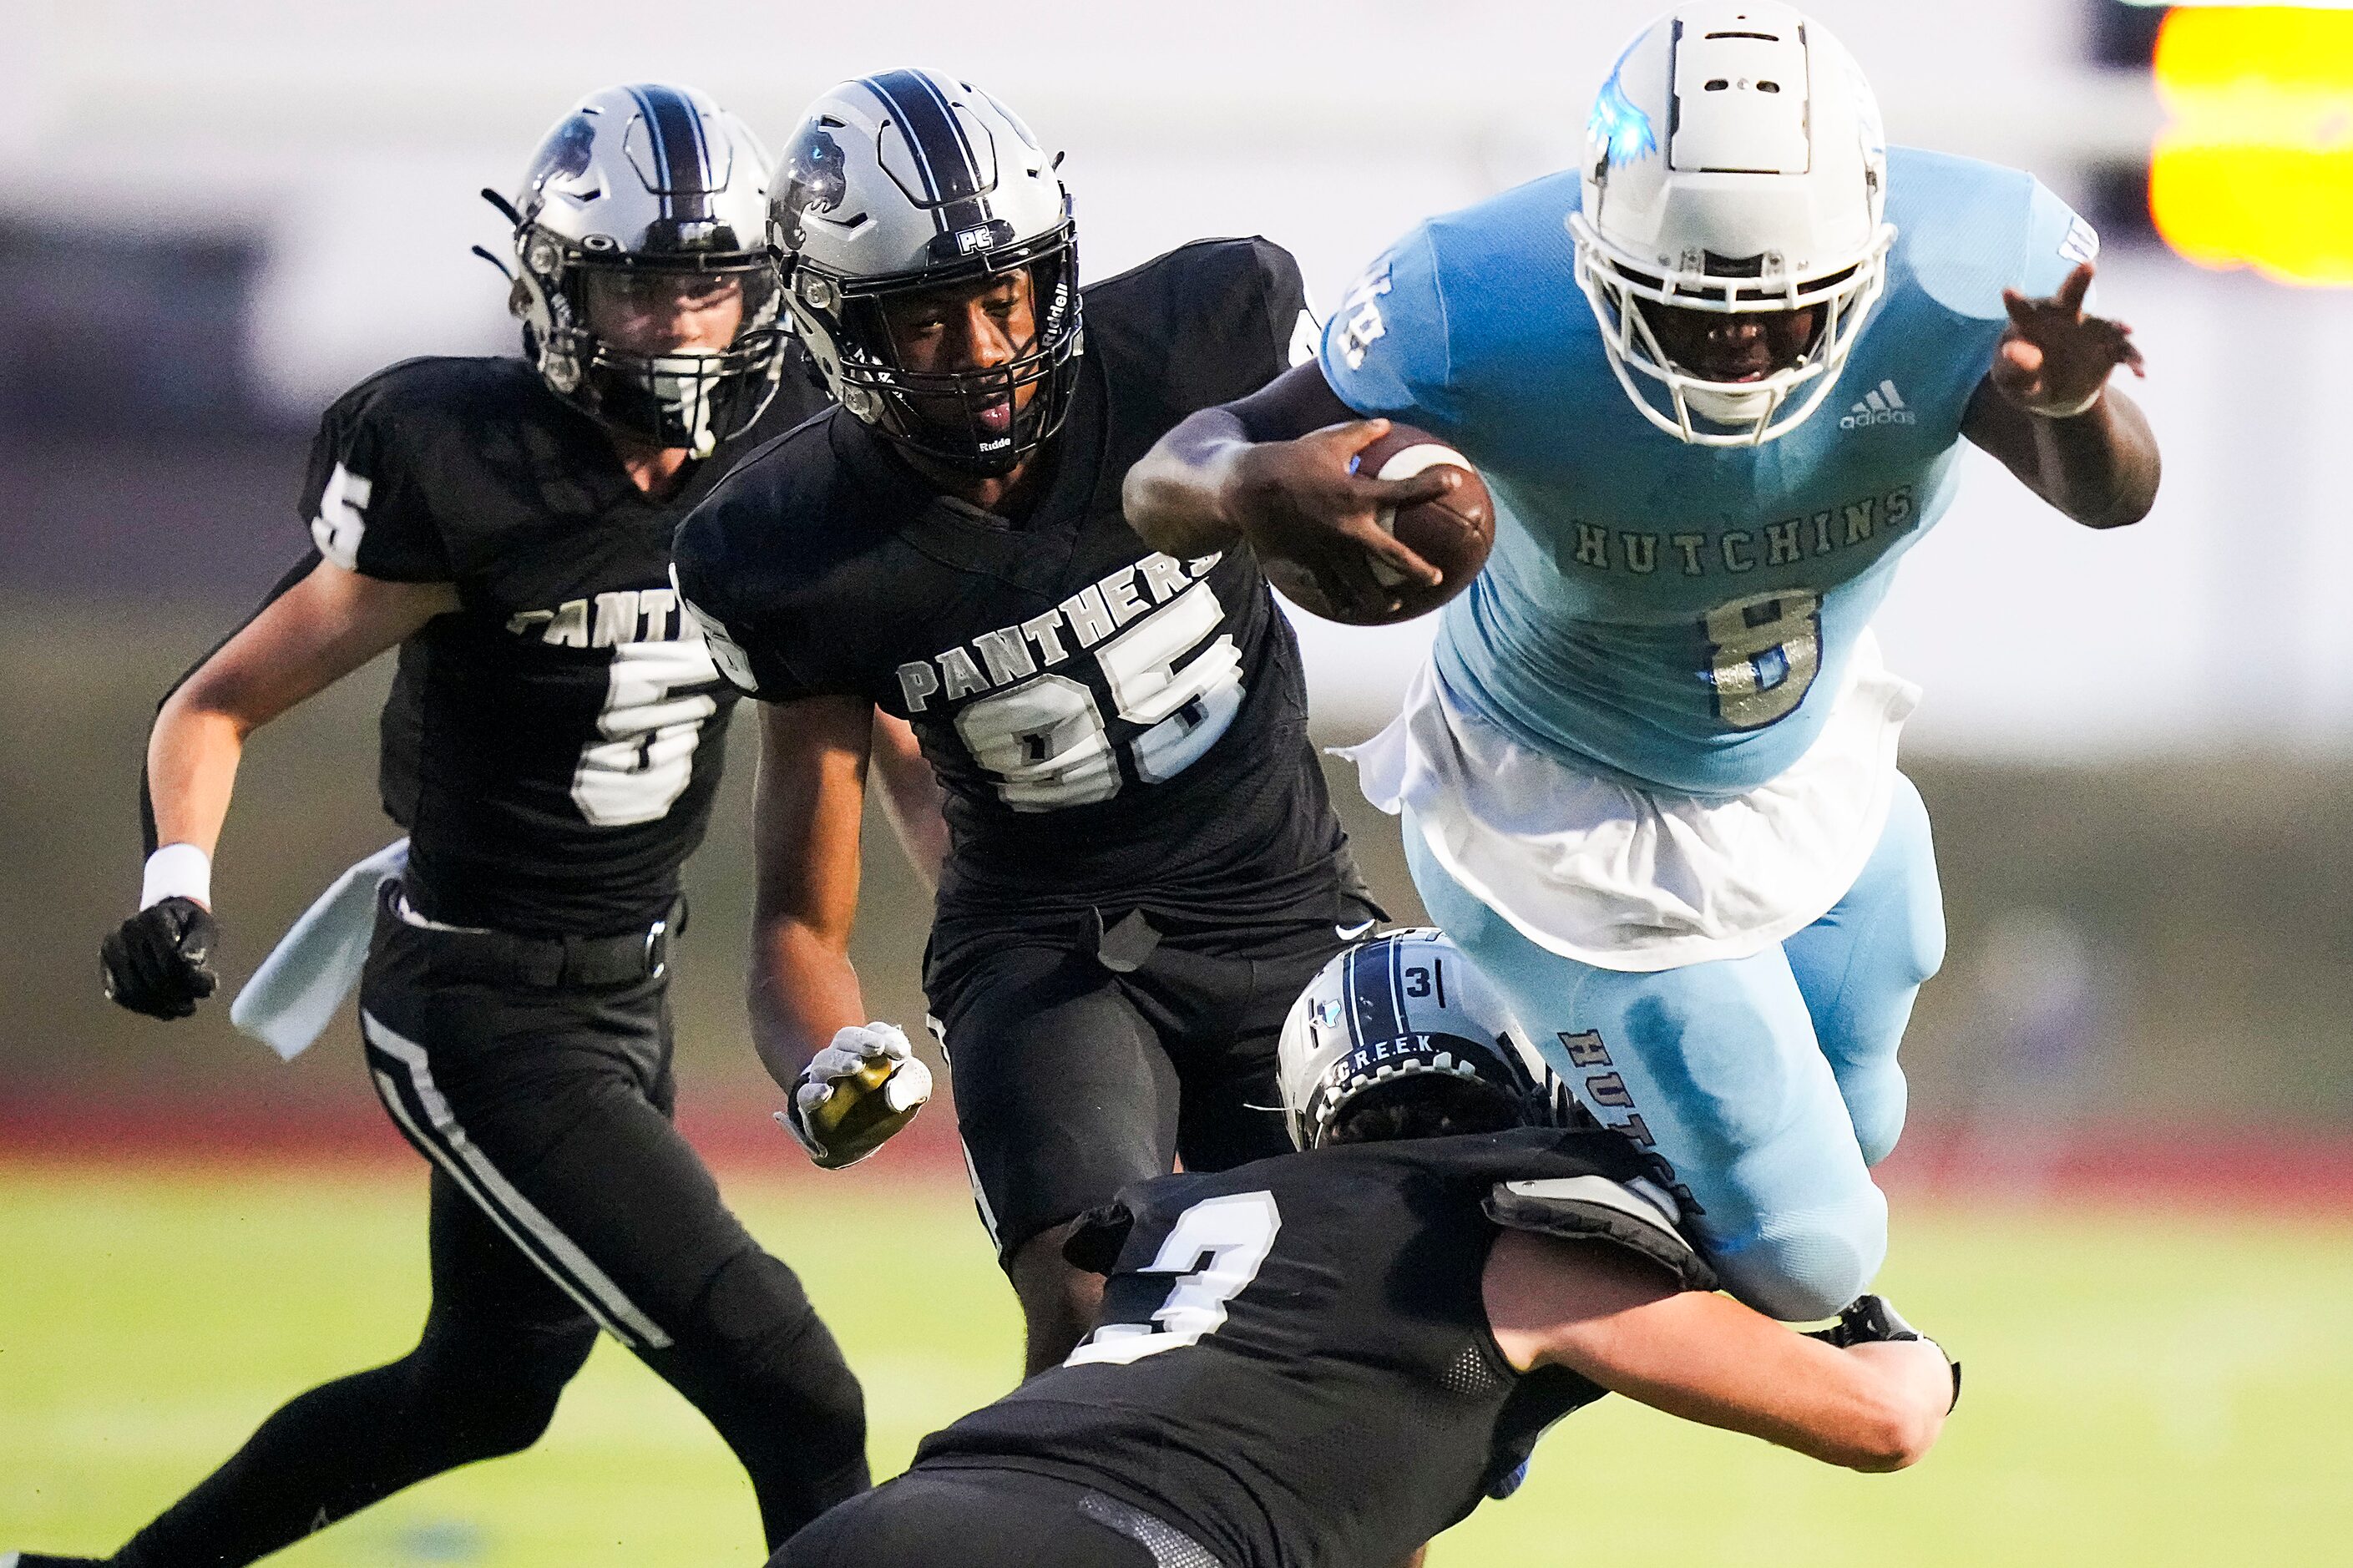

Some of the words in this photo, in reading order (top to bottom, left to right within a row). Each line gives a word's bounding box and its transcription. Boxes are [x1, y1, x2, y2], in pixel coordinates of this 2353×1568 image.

[954, 225, 994, 256] PC
[1839, 408, 1916, 429] adidas
[311, 460, 373, 571] 5
[1574, 484, 1915, 577] HUTCHINS
[1705, 588, 1824, 733] 8
[569, 638, 721, 827] 5
[1405, 967, 1431, 998] 3
[1062, 1189, 1283, 1368] 3
